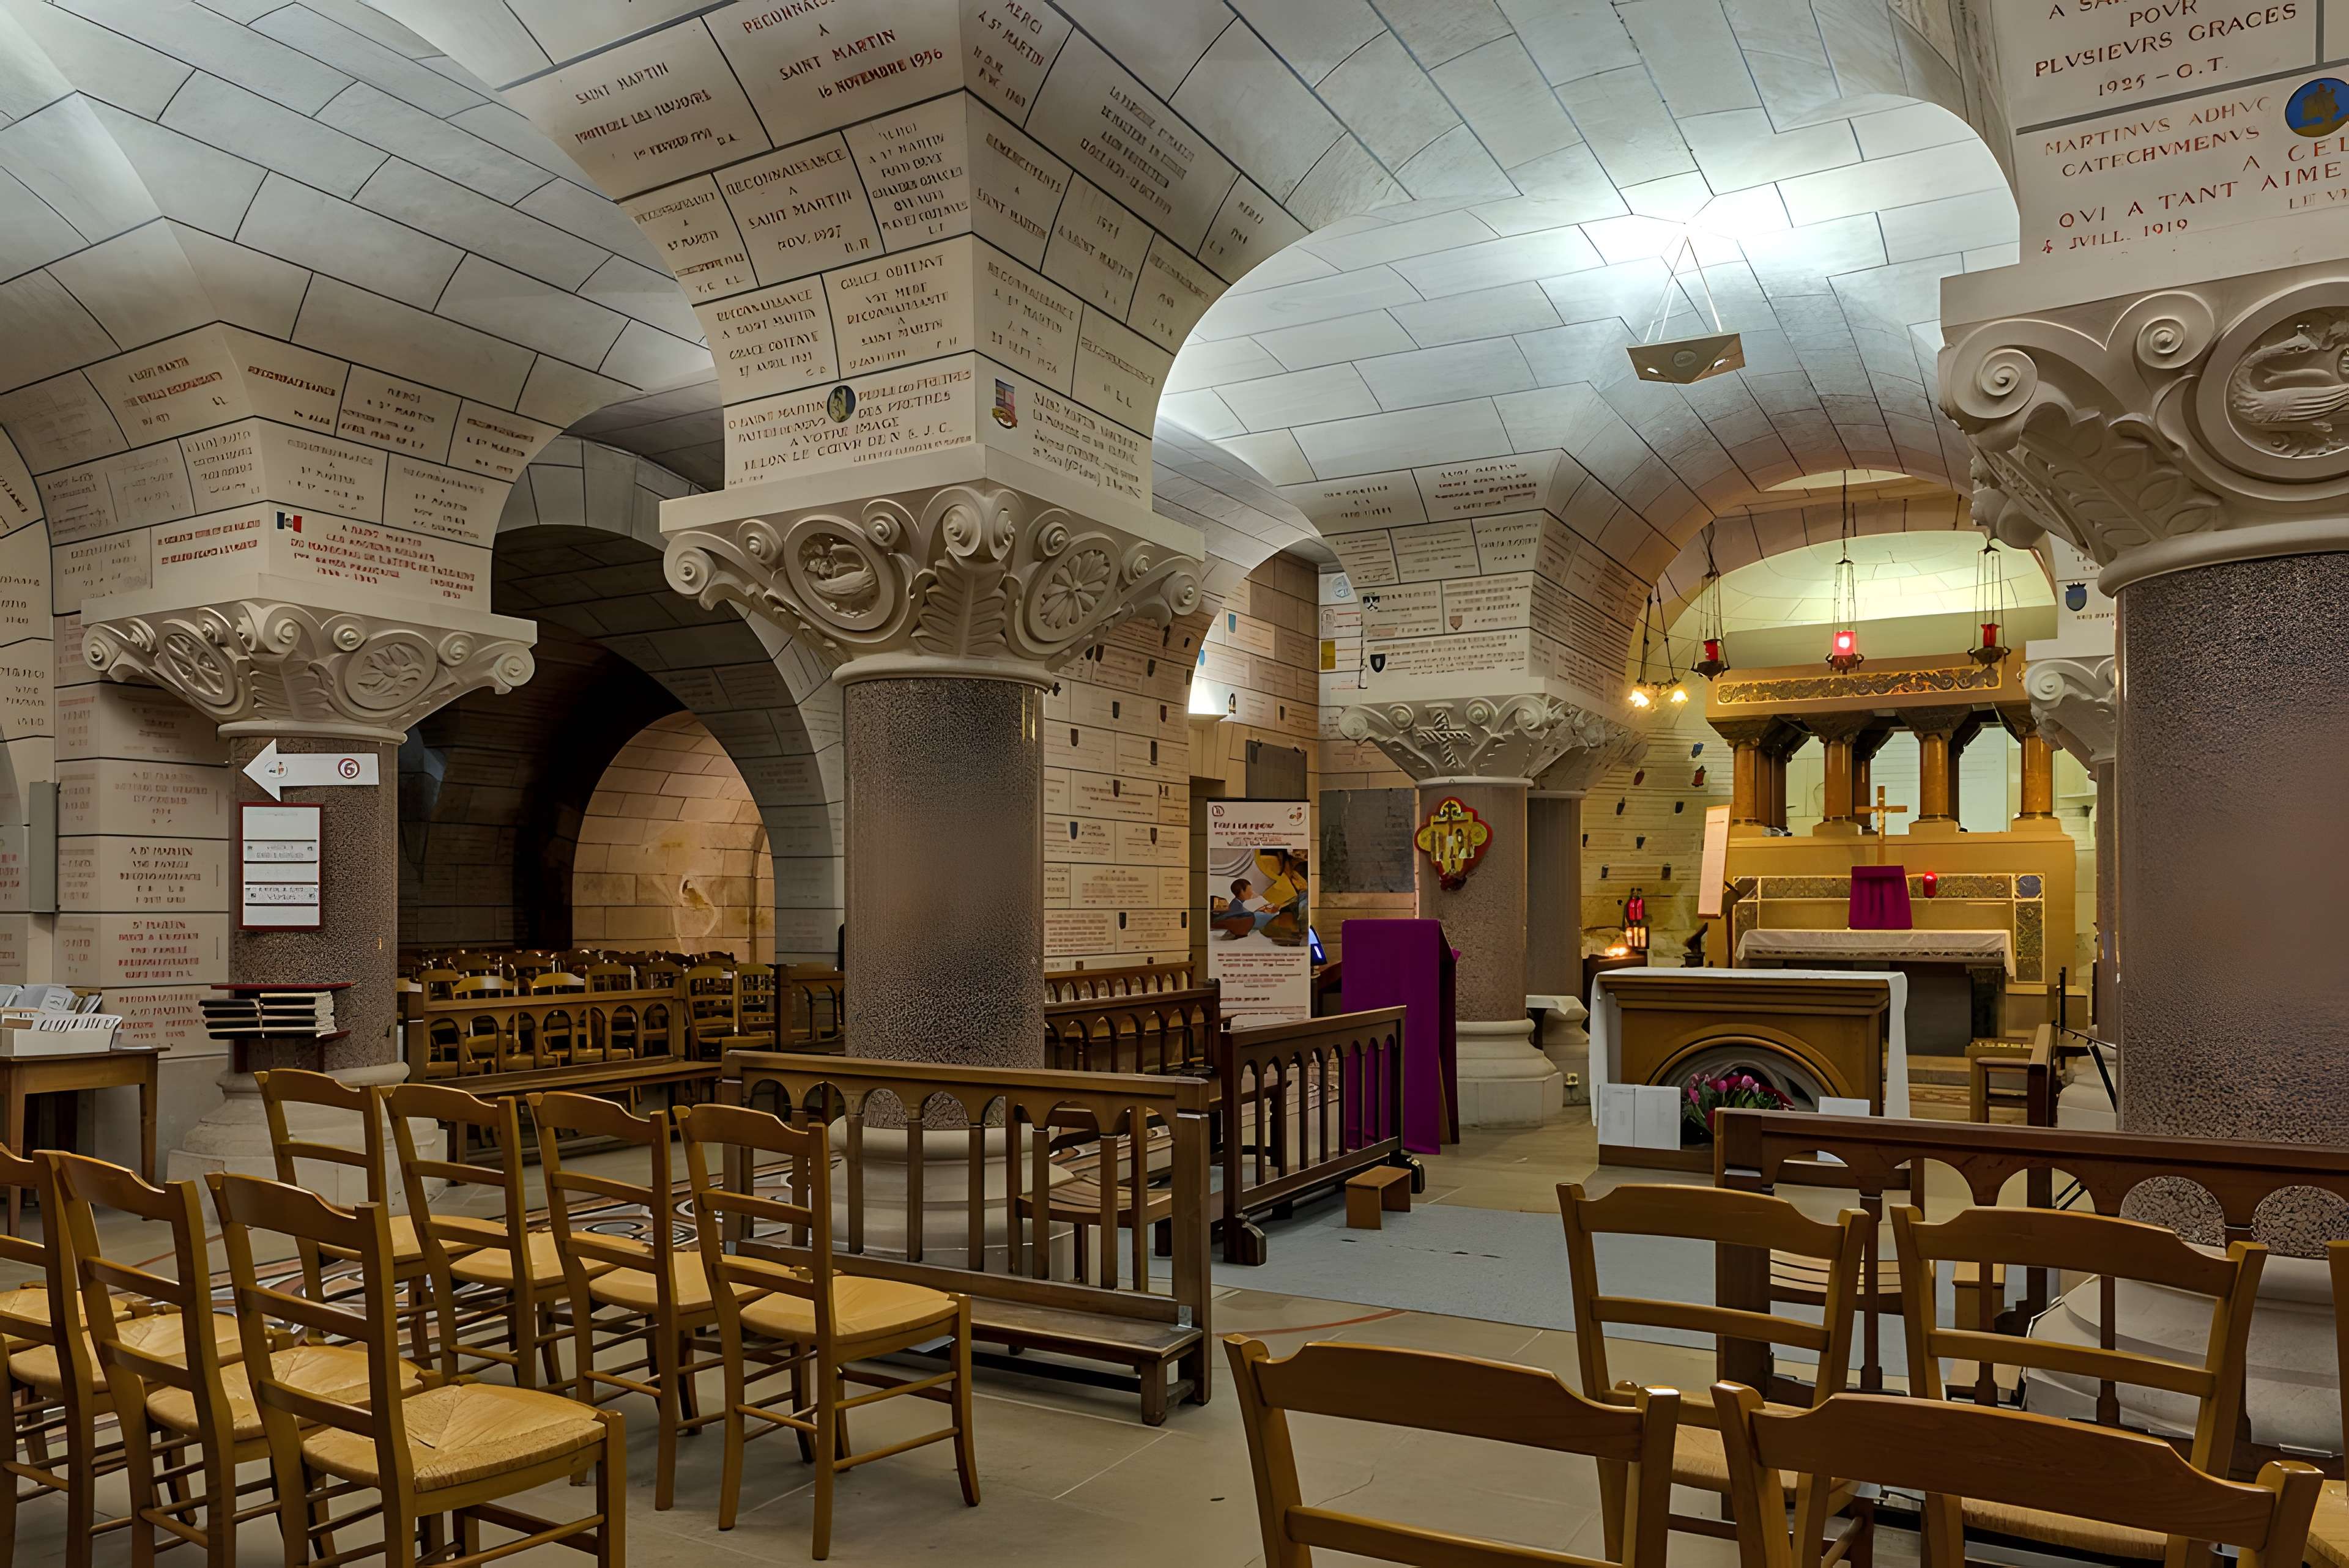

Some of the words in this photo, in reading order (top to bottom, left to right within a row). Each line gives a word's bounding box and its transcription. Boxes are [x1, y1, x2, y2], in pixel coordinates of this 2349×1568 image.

[2049, 4, 2065, 20] A
[779, 56, 823, 81] SAINT
[831, 29, 896, 62] MARTIN
[2036, 31, 2173, 77] PLVSIEVRS
[2189, 3, 2296, 41] GRACES
[2062, 125, 2260, 177] CATECHVMENVS
[2243, 155, 2260, 172] A
[2128, 201, 2144, 216] A
[2158, 181, 2239, 210] TANT
